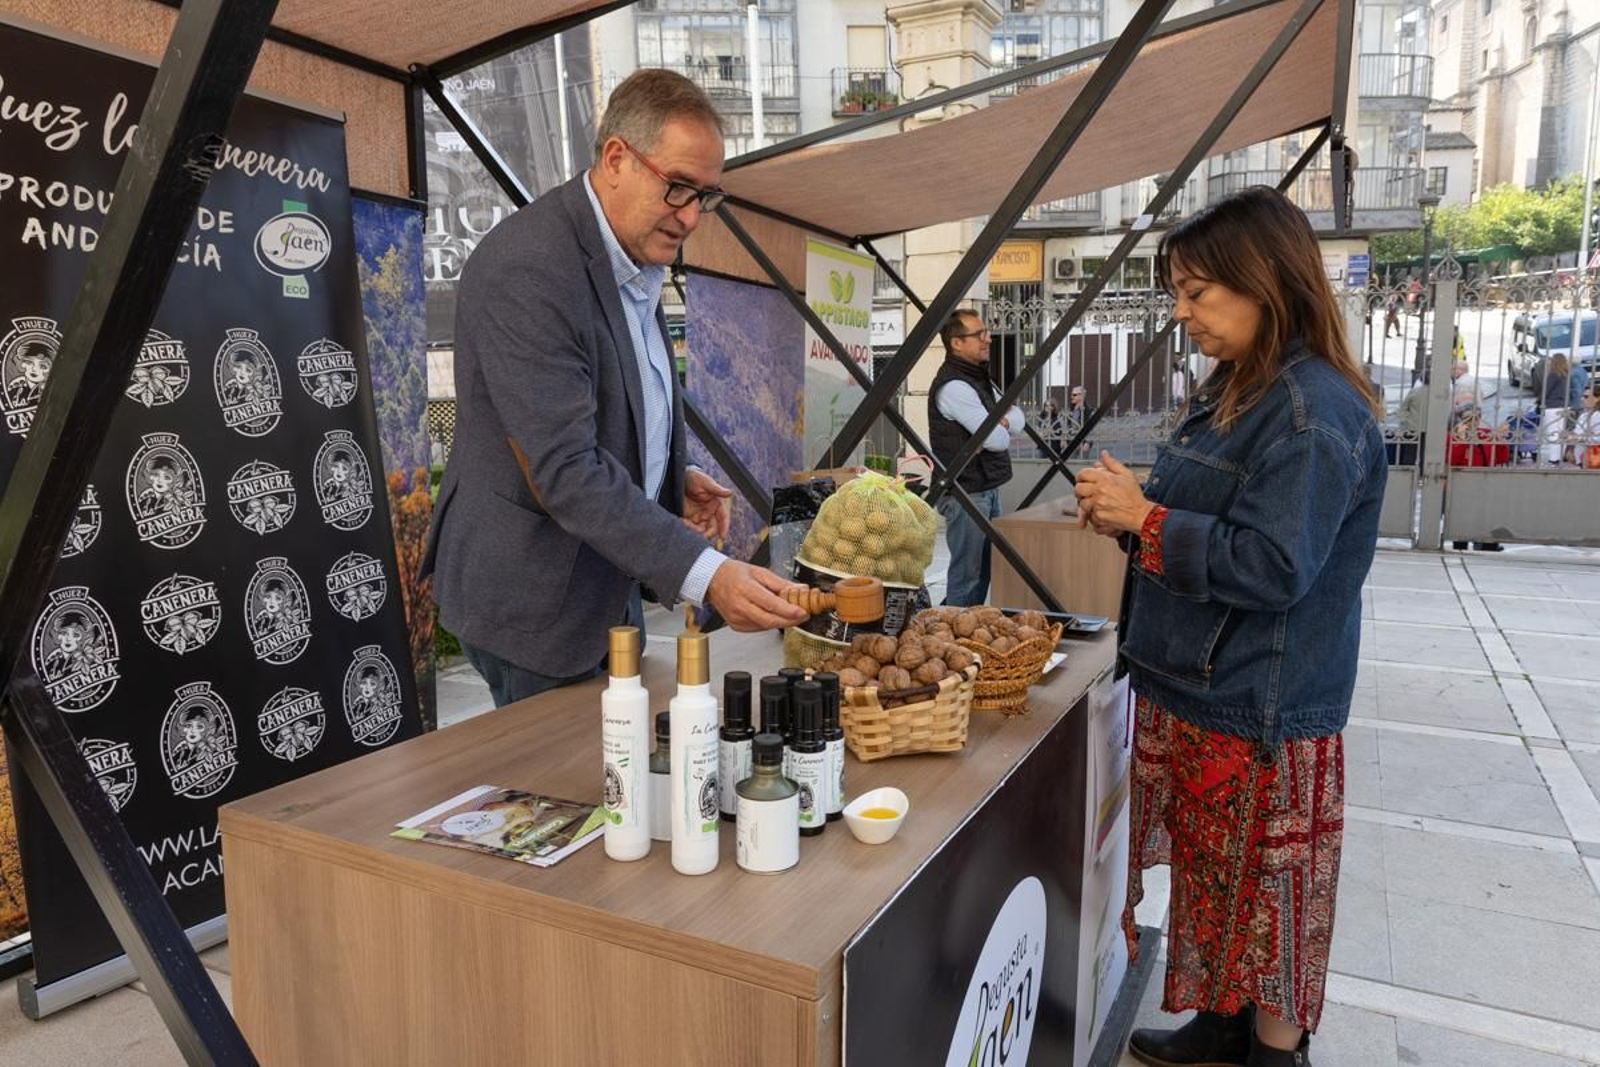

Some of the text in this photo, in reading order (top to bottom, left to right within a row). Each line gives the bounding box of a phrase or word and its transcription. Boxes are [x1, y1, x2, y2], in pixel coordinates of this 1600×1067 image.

[0, 73, 89, 151] uez
[214, 142, 331, 193] nenera
[198, 206, 235, 233] DE
[285, 285, 308, 296] ECO
[22, 319, 49, 329] NUEZ
[137, 344, 187, 362] ENERA
[298, 354, 354, 374] CANENERA
[223, 399, 281, 425] CANENERA
[227, 474, 294, 500] CANENERA
[321, 494, 372, 521] CANENERA
[138, 506, 206, 538] CANENERA
[326, 564, 384, 592] CANENERA
[58, 588, 82, 599] NUEZ
[141, 586, 217, 620] CANENERA
[254, 623, 310, 656] CANENERA
[48, 662, 118, 701] ANENERA
[258, 695, 322, 732] CANENERA
[352, 705, 401, 740] CANENERA
[171, 751, 236, 795] CANENERA
